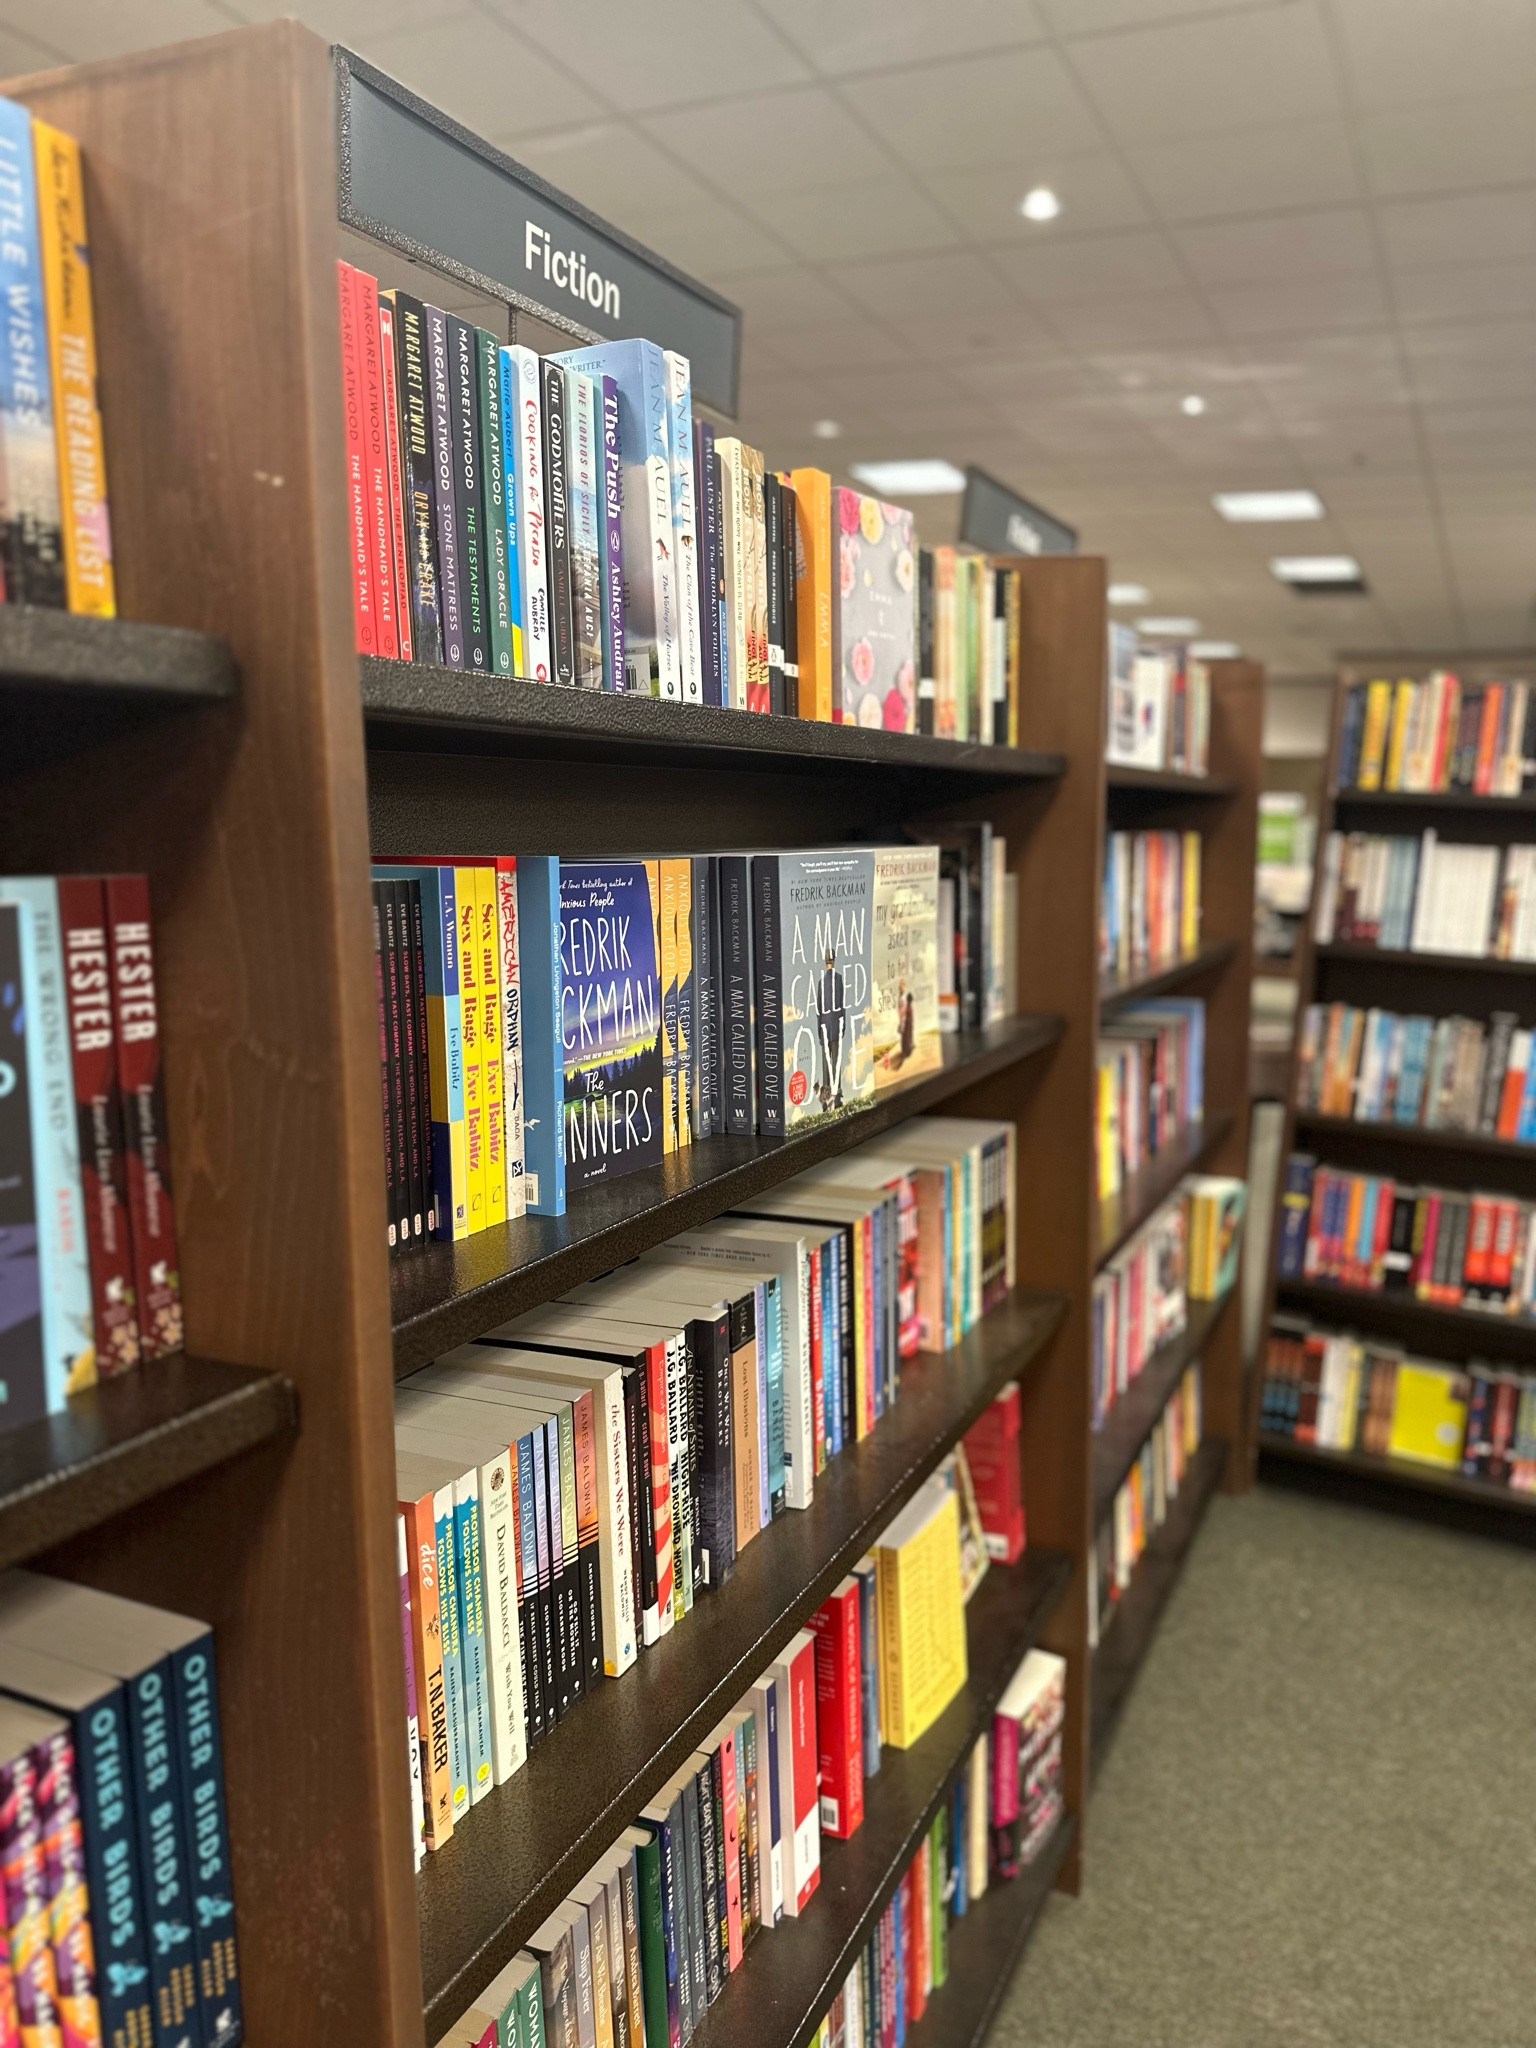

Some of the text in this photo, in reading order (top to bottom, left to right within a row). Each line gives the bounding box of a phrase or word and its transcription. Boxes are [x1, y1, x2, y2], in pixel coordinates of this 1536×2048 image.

[525, 220, 620, 320] Fiction
[7, 284, 40, 424] WISHES
[60, 333, 91, 388] THE
[404, 311, 423, 390] MARGARET
[63, 392, 99, 526] READING
[340, 268, 369, 612] MARGARET ATWOOD THE HANDMAID'S TALE
[363, 285, 391, 621] MARGARET ATWOOD THE HANDMAID'S TALE
[409, 394, 426, 455] ATWOOD
[433, 317, 458, 631] MARGARET ATWOOD STONE MATTRESS
[604, 394, 619, 447] The
[648, 347, 662, 414] JEAN
[655, 456, 667, 524] AUEL
[705, 436, 713, 477] PAUL
[414, 491, 430, 529] ORYX
[458, 327, 481, 634] MARGARET ATWOOD THE TESTAMENTS
[487, 340, 508, 629] MARGARET ATWOOD LADY ORACLE
[550, 379, 567, 656] THE GODMOTHERS CAMILLE AUBRAY
[577, 383, 595, 637] THE FLORIOS OF SICILY STEFANIA AUCI
[606, 449, 621, 519] Push
[707, 479, 715, 534] AUSTER
[76, 527, 105, 589] LIST
[611, 560, 621, 624] Ashley
[710, 565, 718, 631] BROOKLYN
[790, 881, 866, 903] FREDRIK BACKMAN
[876, 863, 905, 878] FREDRIK
[114, 922, 157, 1043] HESTER
[444, 894, 454, 969] L.A. Woman
[500, 880, 520, 1052] AMERICAN ORPHAN
[553, 965, 561, 1010] Livingston
[560, 915, 632, 977] REDRIK
[792, 907, 866, 965] A MAN
[887, 928, 909, 950] asked
[67, 927, 113, 1052] HESTER
[461, 905, 482, 1172] Sex and Rage Eve Babitz
[482, 903, 501, 1165] Sex and Rage Eve Babitz
[561, 974, 654, 1050] CKMAN
[663, 875, 678, 1120] ANXIOUS PEOPLE FREDRIK BACKMAN
[730, 878, 747, 1100] FREDRIK BACKMAN A MAN CALLED OVE
[791, 963, 867, 1020] CALLED
[584, 1070, 605, 1093] The
[793, 1012, 867, 1105] OVE
[591, 1162, 607, 1177] novel
[677, 1344, 689, 1529] J.G. BALLARD HIGH-RISE
[724, 1390, 730, 1411] WE
[815, 1378, 825, 1442] BANKS
[519, 1443, 536, 1573] JAMES BALDWIN
[561, 1415, 576, 1543] JAMES BALDWIN
[580, 1404, 592, 1518] JAMES BALDWIN
[611, 1403, 626, 1557] the Sisters We Were
[666, 1350, 683, 1590] J.G. BALLARD THE DROWNED WORLD
[420, 1541, 435, 1590] dice
[437, 1538, 450, 1656] FOLLOWS HIS BLISS
[445, 1522, 459, 1658] PROFESSOR CHANDRA
[462, 1520, 475, 1635] FOLLOWS HIS BLISS
[468, 1505, 484, 1638] PROFESSOR CHANDRA
[497, 1524, 511, 1649] DAVID BALDACCI
[138, 1672, 179, 1906] OTHER BIRDS
[184, 1653, 222, 1881] OTHER BIRDS
[91, 1707, 136, 1948] OTHER BIRDS
[625, 1876, 637, 1935] Archangel
[578, 1944, 592, 2014] Ship Fever
[630, 1945, 638, 1989] Andrea
